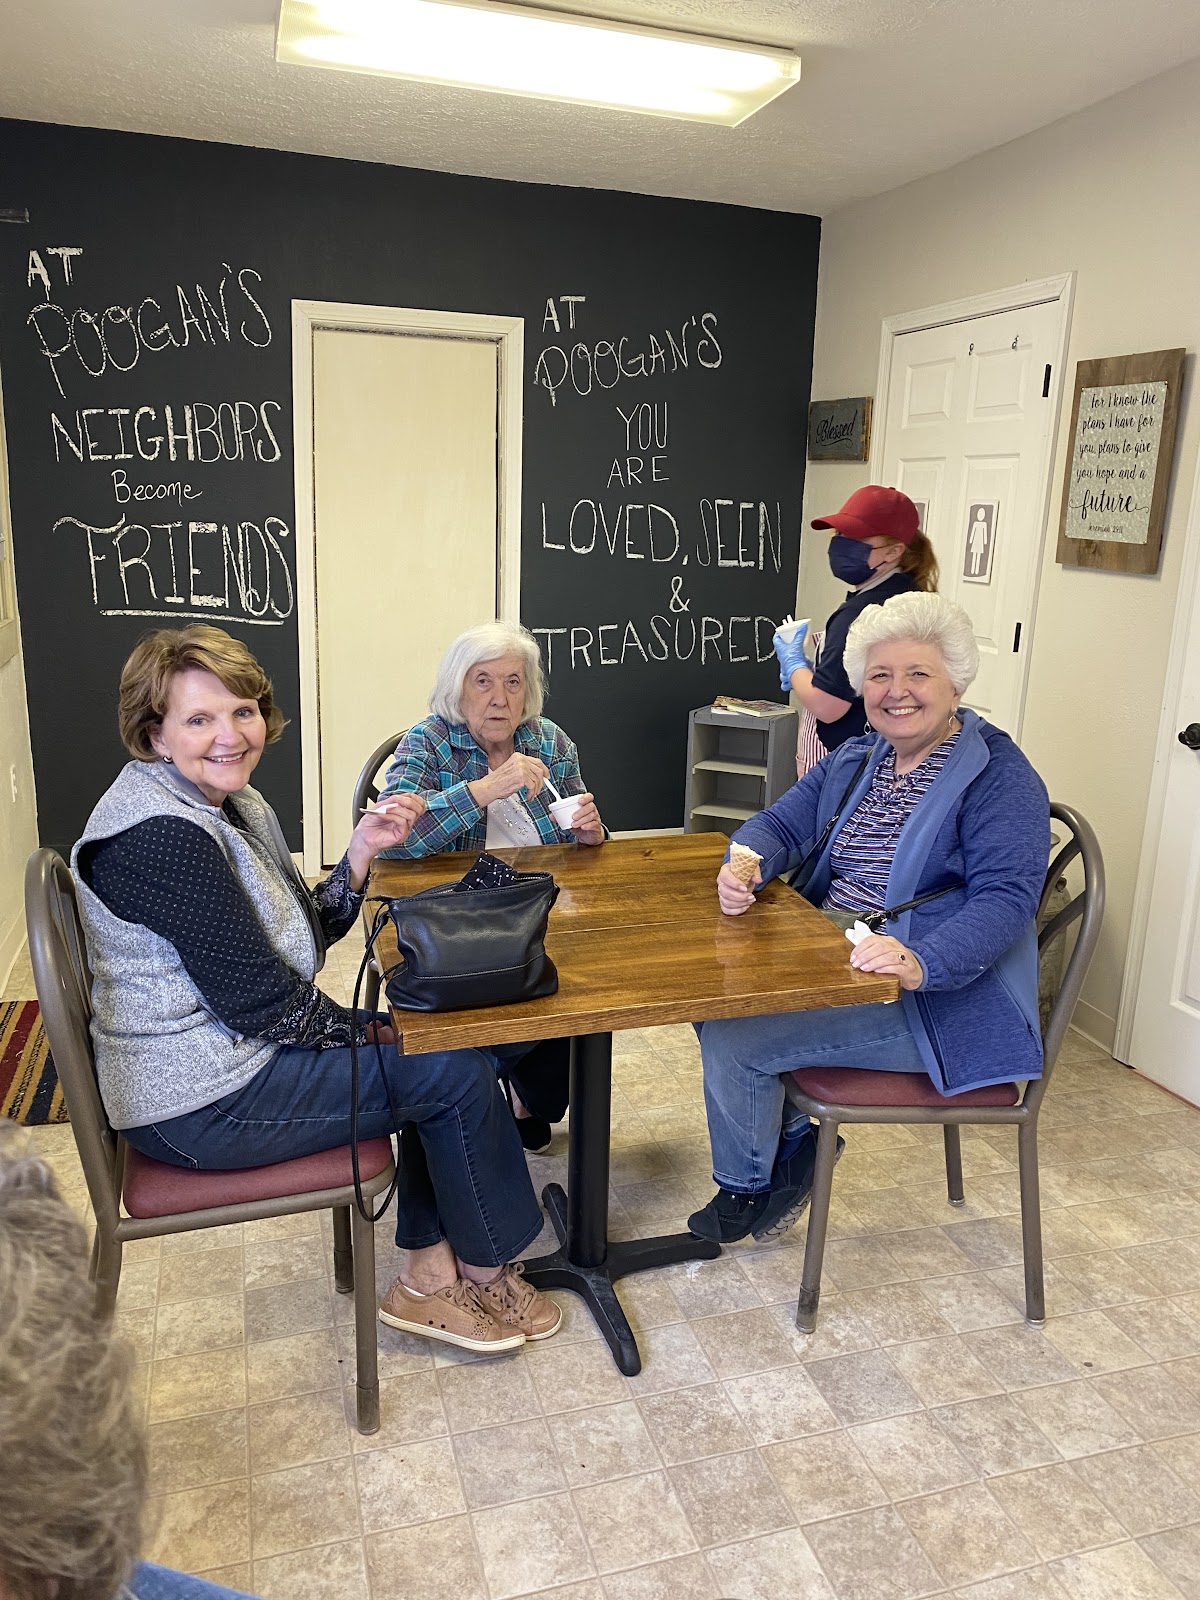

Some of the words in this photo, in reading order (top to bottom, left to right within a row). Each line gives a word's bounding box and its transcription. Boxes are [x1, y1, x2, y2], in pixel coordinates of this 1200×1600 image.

[27, 247, 83, 287] AT
[26, 262, 272, 399] POOGAN'S
[542, 295, 586, 333] AT
[533, 312, 723, 407] POOGAN'S
[1113, 393, 1139, 407] know
[1141, 391, 1157, 406] the
[51, 400, 282, 463] NEIGHBORS
[616, 402, 668, 451] YOU
[815, 409, 858, 445] Blessed
[1082, 416, 1106, 435] plans
[1114, 413, 1136, 428] have
[1137, 414, 1155, 433] for
[1098, 440, 1120, 459] plans
[1122, 439, 1132, 454] to
[1134, 439, 1152, 459] give
[111, 469, 203, 506] Become
[607, 455, 670, 488] ARE
[1076, 468, 1094, 484] you
[1096, 465, 1117, 484] hope
[1118, 464, 1137, 480] and
[1139, 469, 1147, 480] a
[1069, 489, 1149, 520] future
[541, 499, 689, 566] LOVED,
[696, 498, 782, 573] SEEN
[52, 513, 294, 618] FRIENDS
[669, 576, 691, 613] &
[531, 615, 778, 675] TREASURED
